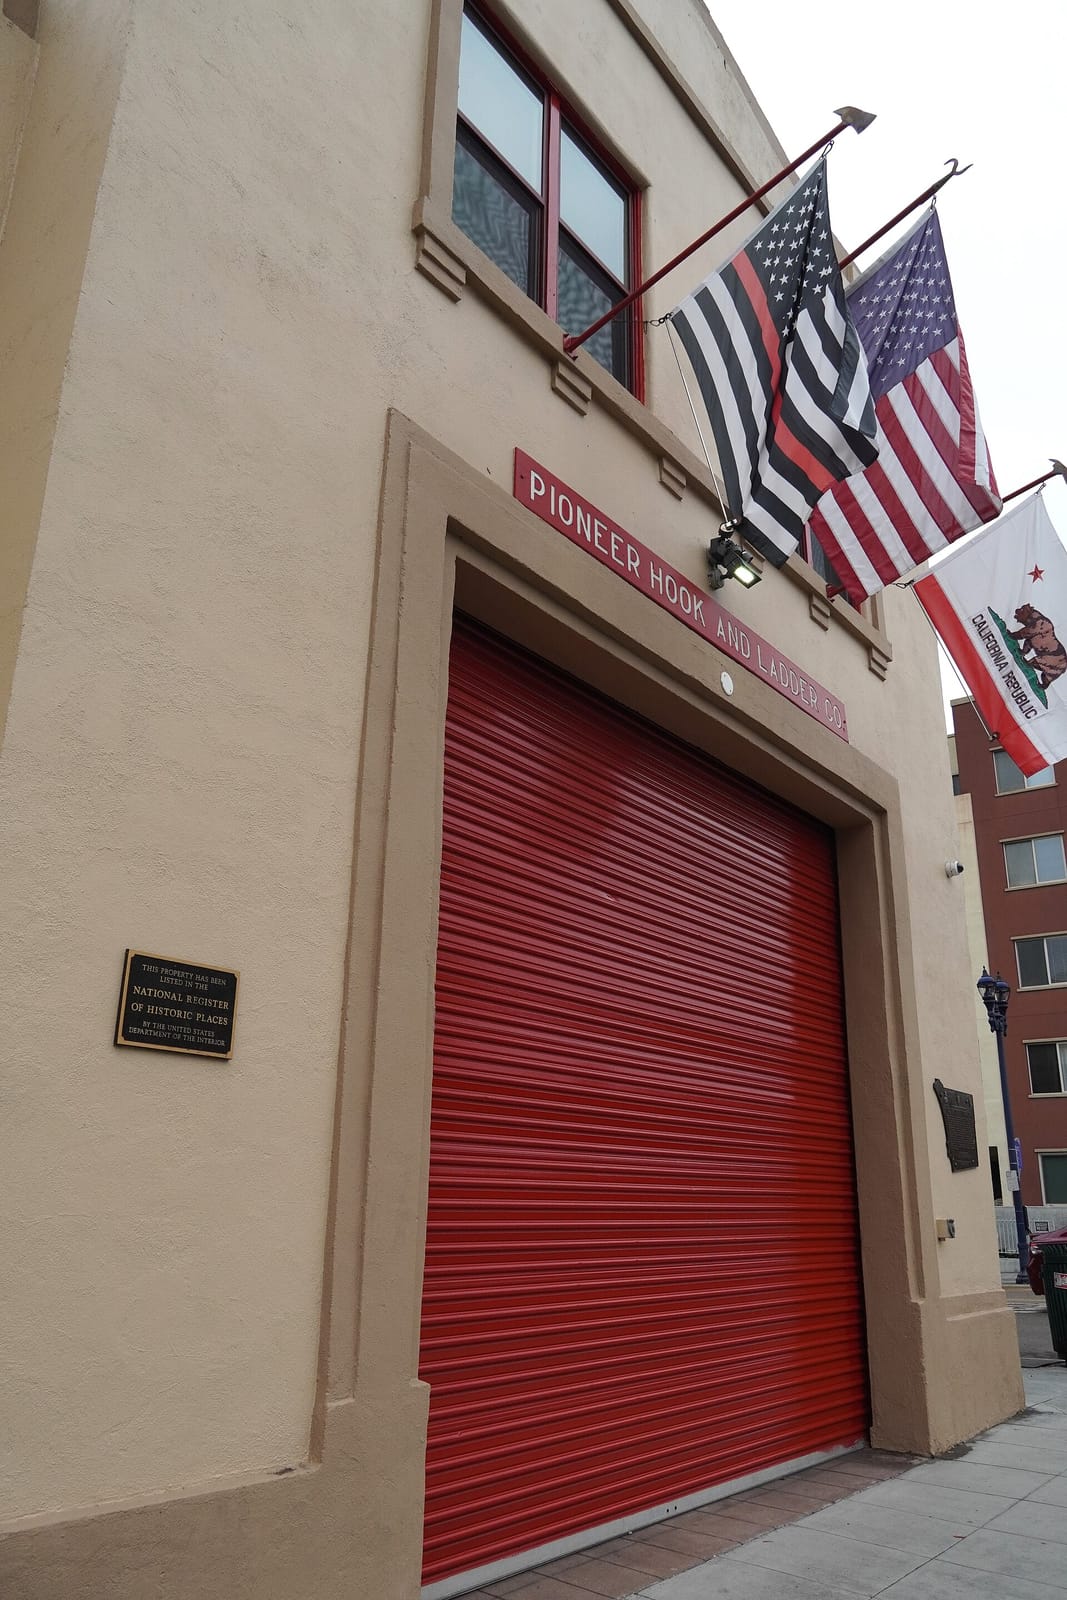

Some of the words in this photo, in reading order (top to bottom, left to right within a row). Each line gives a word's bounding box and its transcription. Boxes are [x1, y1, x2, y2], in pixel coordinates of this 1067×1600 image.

[530, 470, 640, 579] PIONEER
[650, 560, 706, 627] HOOK
[717, 616, 750, 659] AND
[757, 645, 819, 712] LADDER
[972, 613, 1009, 672] CALIFORNIA
[1002, 670, 1038, 720] REPUBLIC
[142, 964, 159, 972] THIS
[160, 967, 194, 980] PROPERTY
[195, 974, 209, 982] HAS
[210, 977, 226, 986] BEEN
[160, 976, 183, 986] LISTED
[195, 982, 209, 991] THE
[132, 986, 183, 1002] NATIONAL
[186, 995, 229, 1010] REGISTER
[131, 1002, 144, 1012] OF
[147, 1005, 193, 1020] HISTORIC
[196, 1013, 228, 1026] PLACES
[128, 1026, 172, 1038] DEPARTMENT
[197, 1036, 225, 1046] INTERIOR
[152, 1022, 166, 1031] THE
[168, 1024, 192, 1034] UNITED
[193, 1028, 215, 1038] STATES
